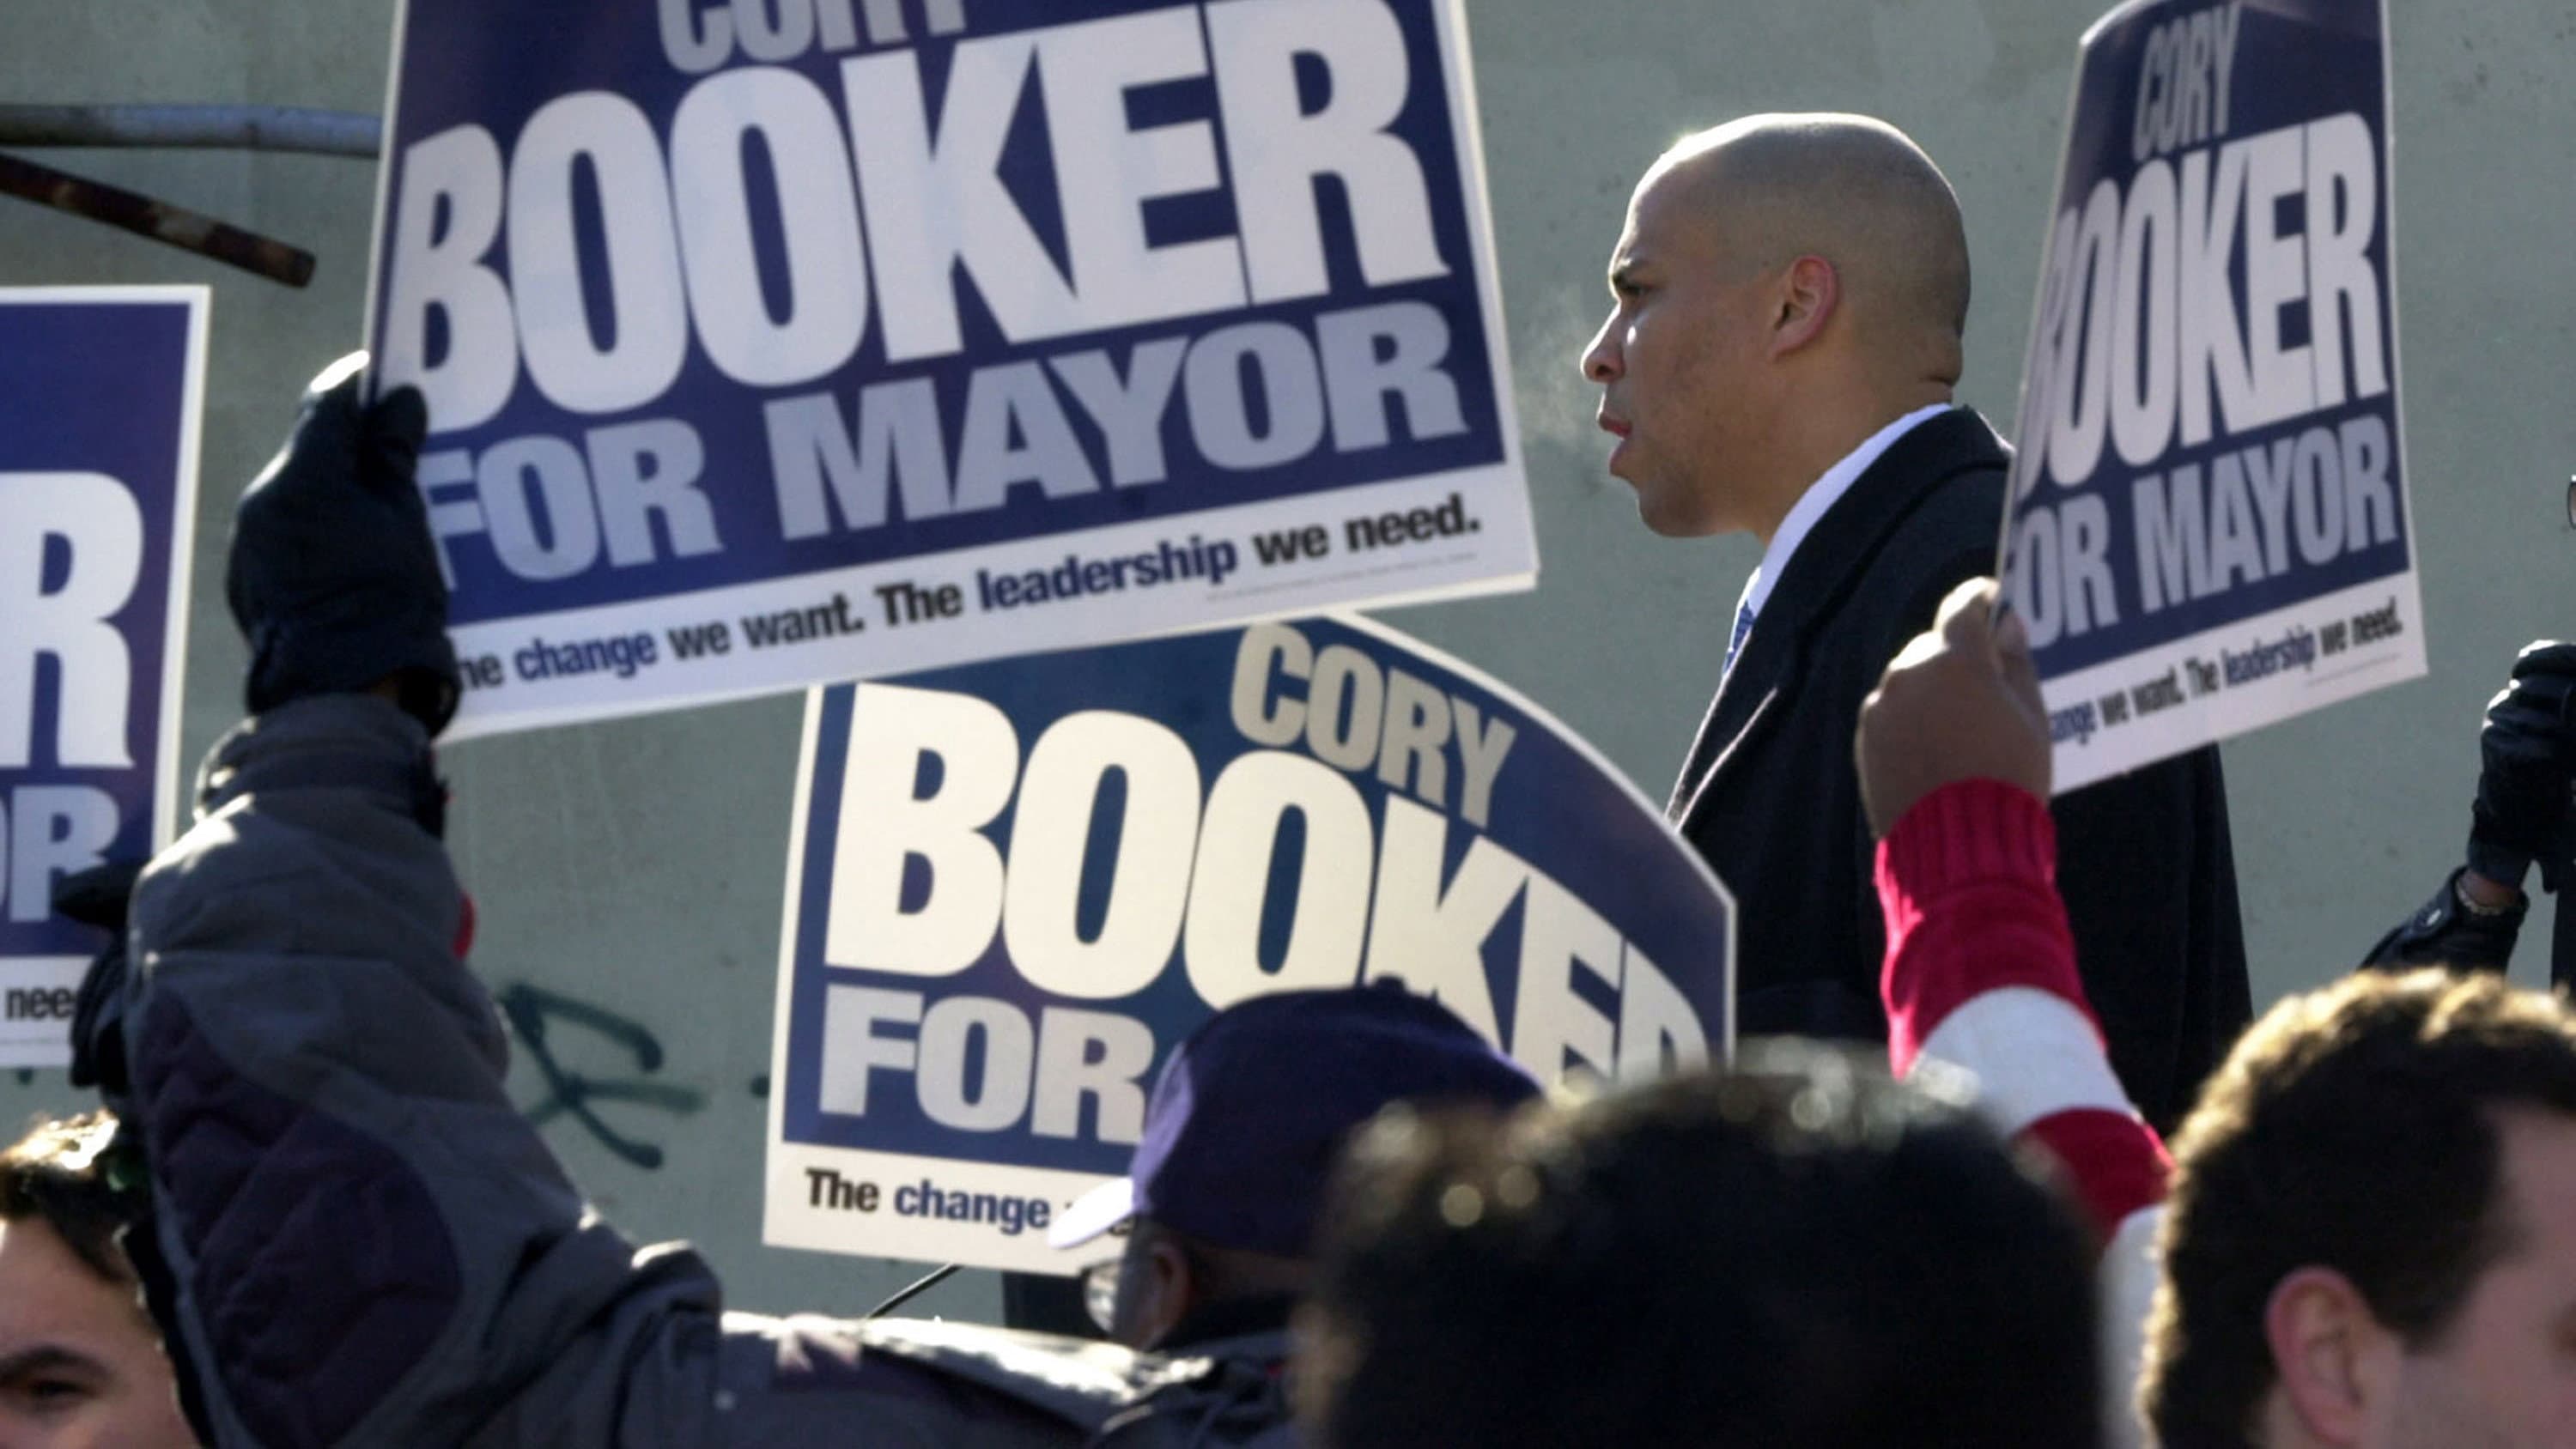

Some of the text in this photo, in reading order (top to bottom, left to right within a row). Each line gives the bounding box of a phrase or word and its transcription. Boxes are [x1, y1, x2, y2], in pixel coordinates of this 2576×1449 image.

[2133, 1, 2241, 163] CORY
[379, 0, 1453, 432] BOOKER
[2015, 112, 2389, 502] BOOKER
[416, 300, 1472, 590] FOR MAYOR
[2131, 412, 2399, 615] MAYOR
[458, 654, 504, 690] he
[513, 634, 658, 679] change
[666, 619, 731, 661] we
[739, 592, 866, 650] want.
[874, 580, 964, 627] The
[975, 534, 1239, 612] leadership
[1252, 523, 1331, 567] we
[1343, 492, 1482, 554] need.
[2049, 699, 2097, 747] ange
[2098, 688, 2130, 728] we
[2183, 655, 2221, 698] The
[2220, 622, 2316, 687] leadership
[2320, 617, 2348, 658] we
[1230, 621, 1518, 829] CORY
[4, 987, 77, 1022] nee
[817, 984, 1155, 1147] FOR
[805, 1166, 880, 1214] The
[894, 1178, 1051, 1236] change
